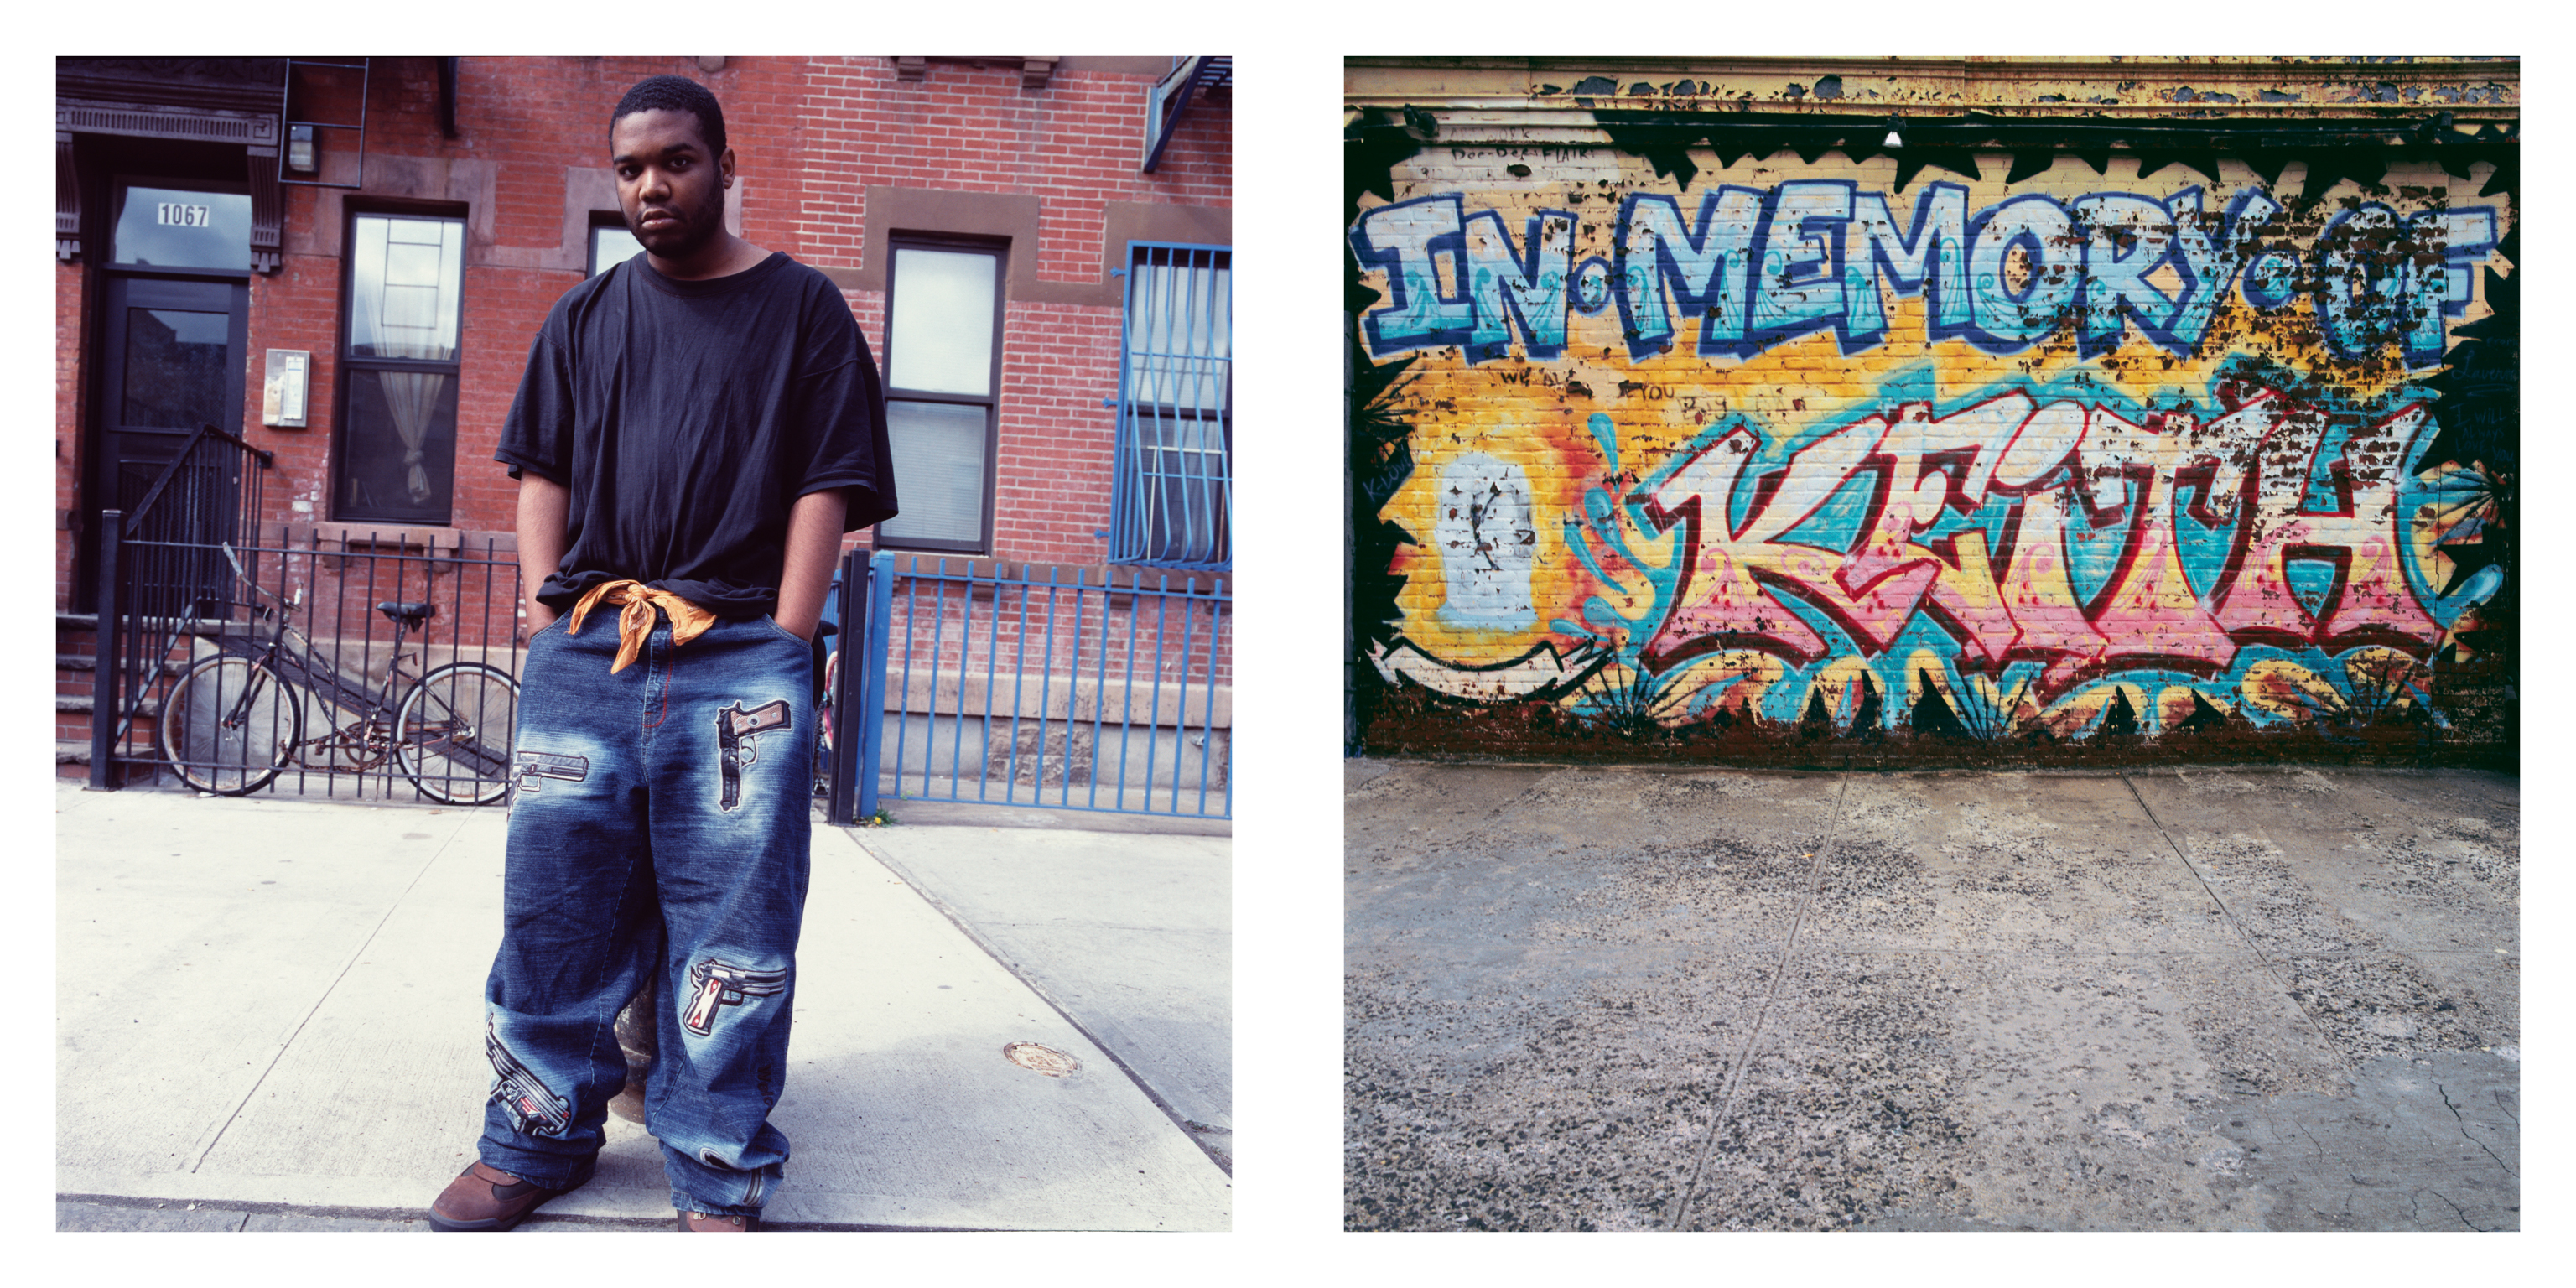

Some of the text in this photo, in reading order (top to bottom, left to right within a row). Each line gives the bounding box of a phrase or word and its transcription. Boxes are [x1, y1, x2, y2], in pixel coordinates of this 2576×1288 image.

[162, 204, 207, 226] 1067
[1348, 180, 2497, 371] IN MEMORY OF
[1645, 382, 2447, 706] KEITH
